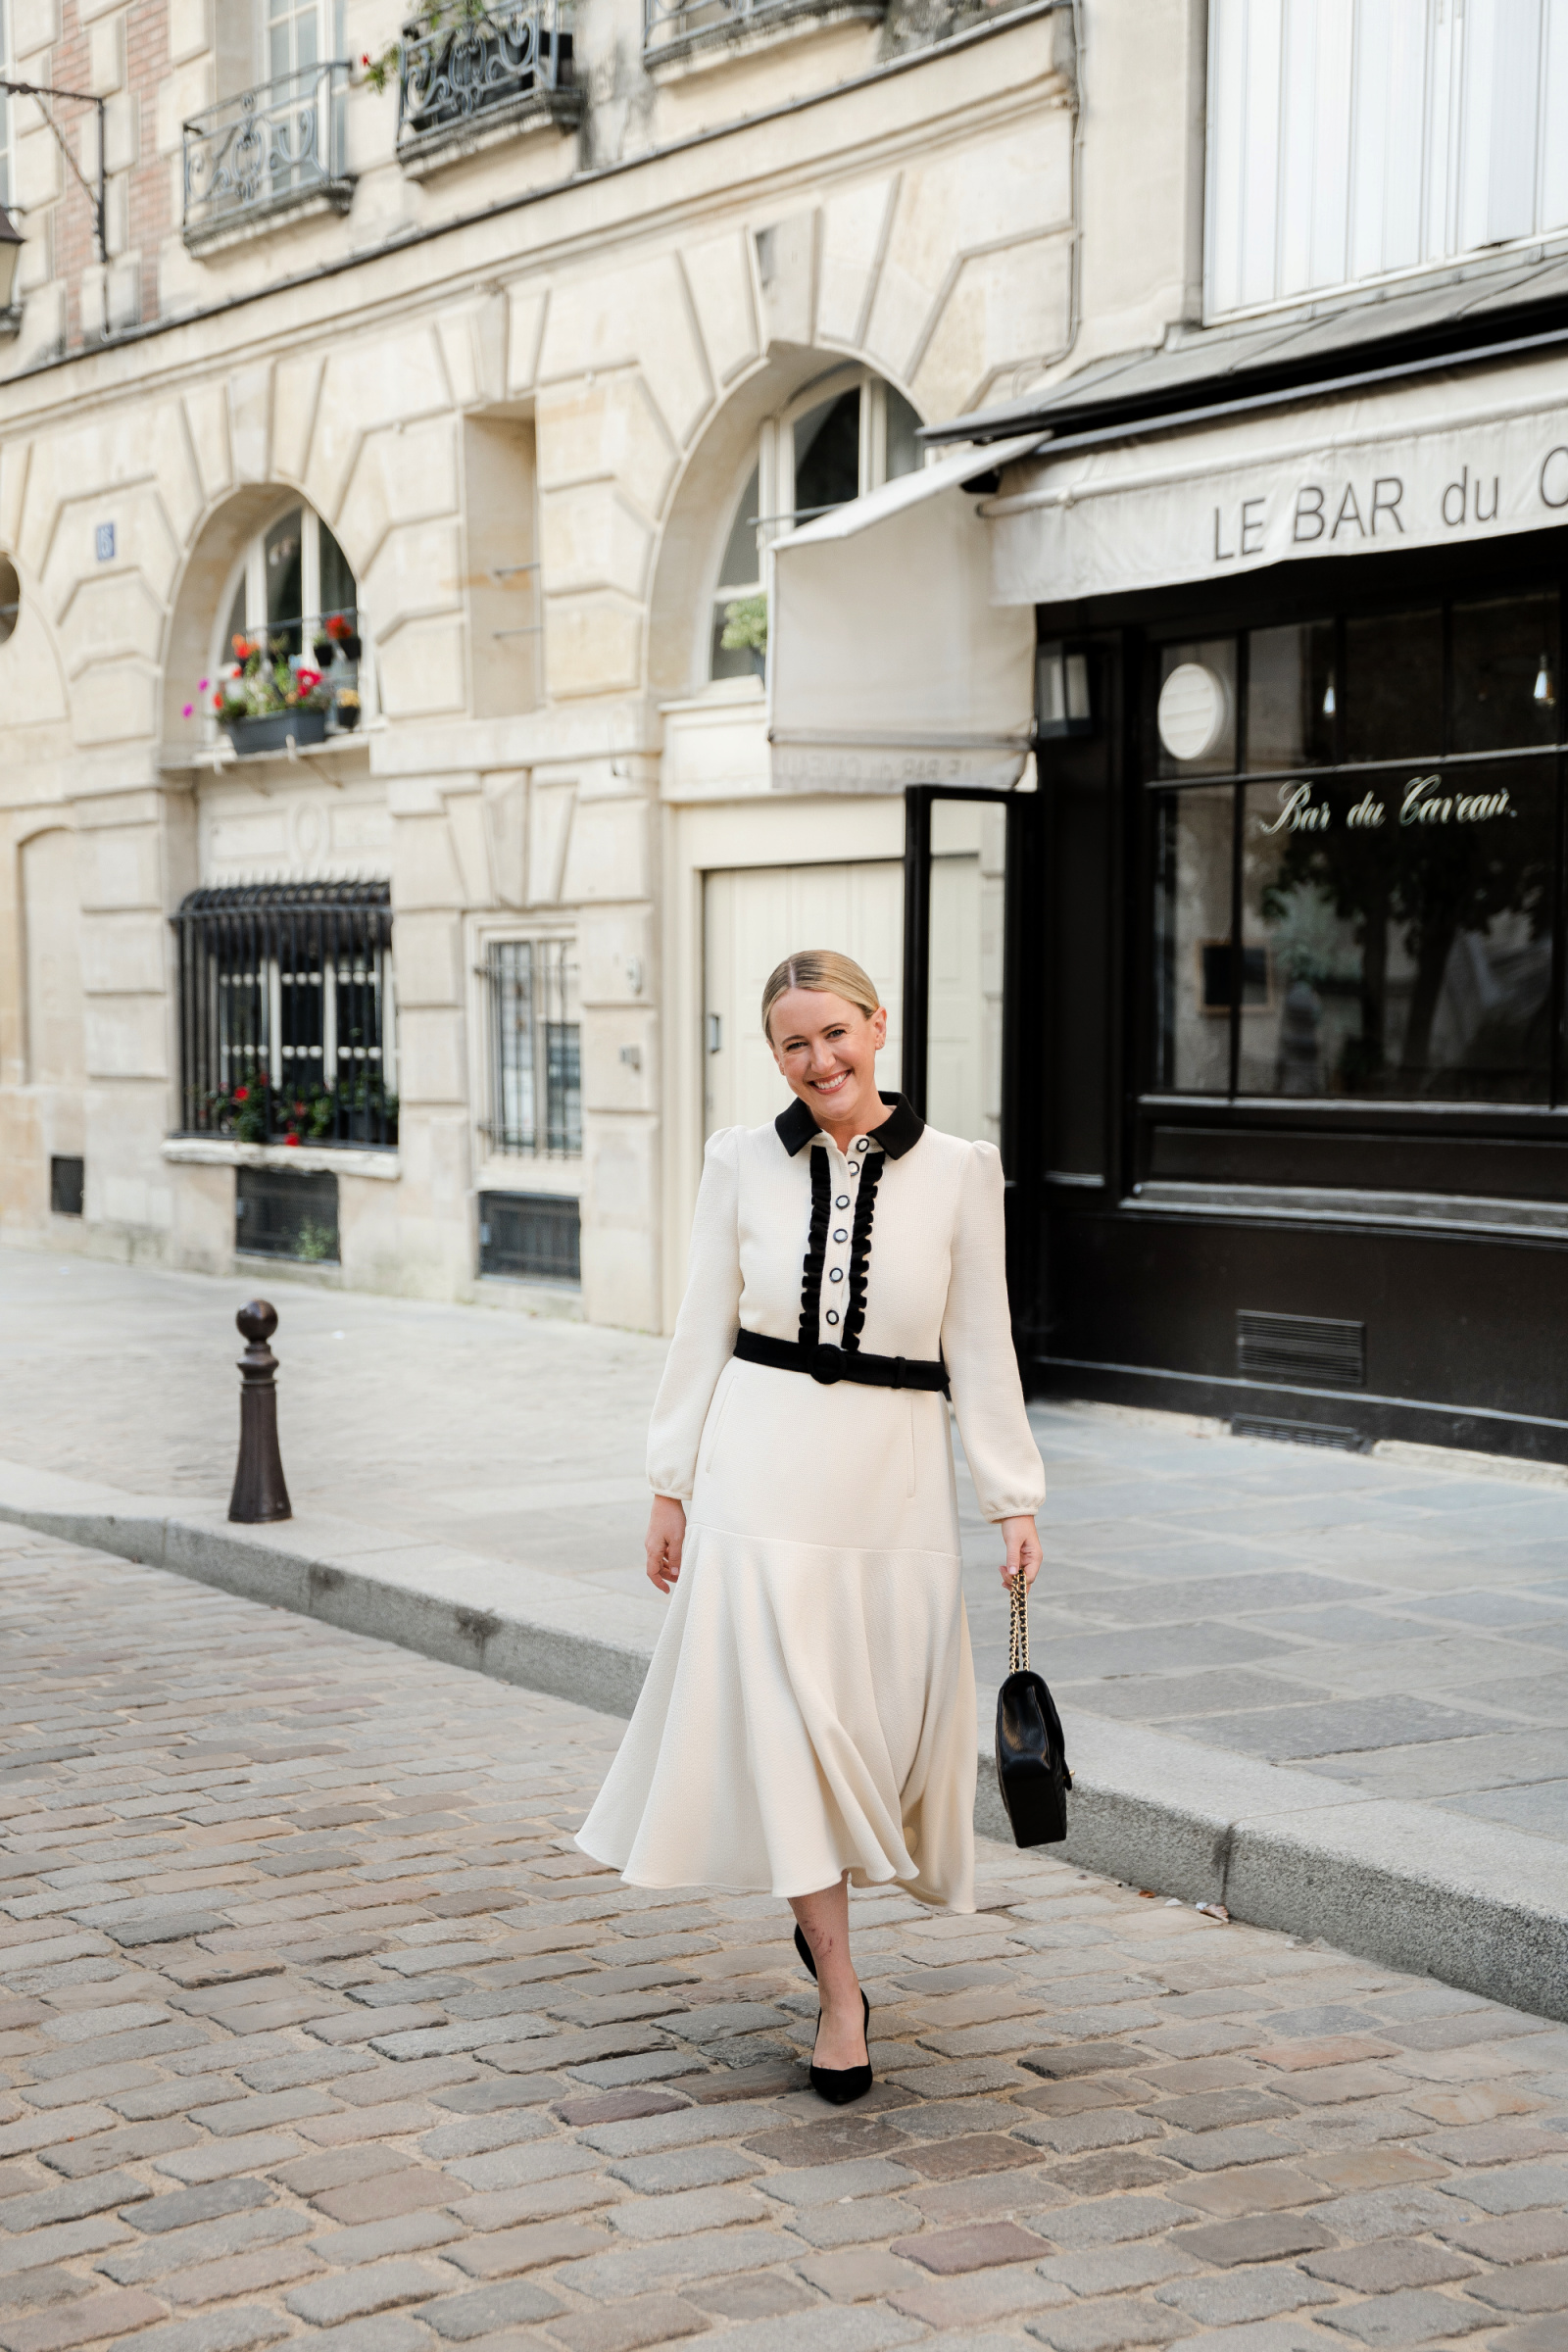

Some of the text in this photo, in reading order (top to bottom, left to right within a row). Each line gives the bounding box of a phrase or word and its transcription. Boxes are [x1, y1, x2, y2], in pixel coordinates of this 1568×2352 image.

[1213, 497, 1266, 562] LE
[1293, 476, 1405, 544] BAR
[1442, 465, 1499, 527] du
[1257, 780, 1332, 835] Bar
[1346, 790, 1386, 830] du
